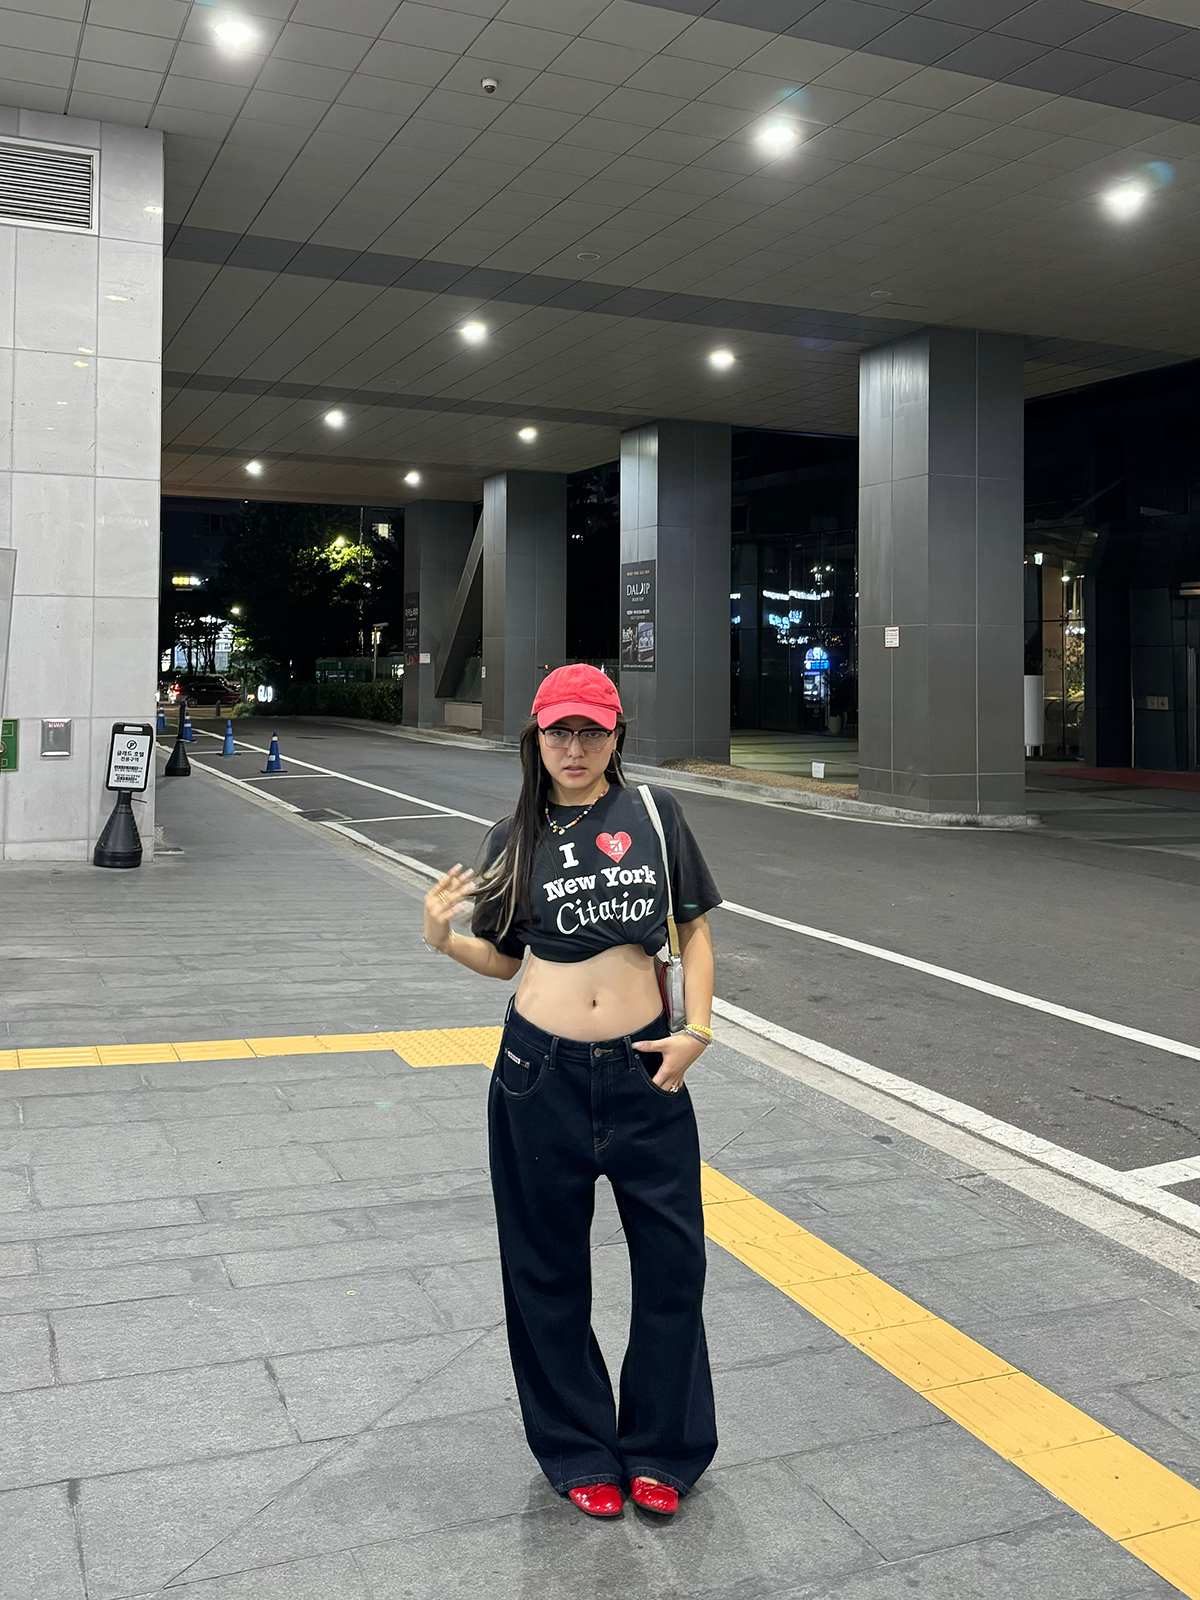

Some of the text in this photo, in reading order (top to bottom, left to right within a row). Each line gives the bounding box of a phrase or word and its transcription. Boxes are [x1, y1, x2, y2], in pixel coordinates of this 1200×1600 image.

[559, 842, 579, 869] I
[542, 865, 657, 902] New York
